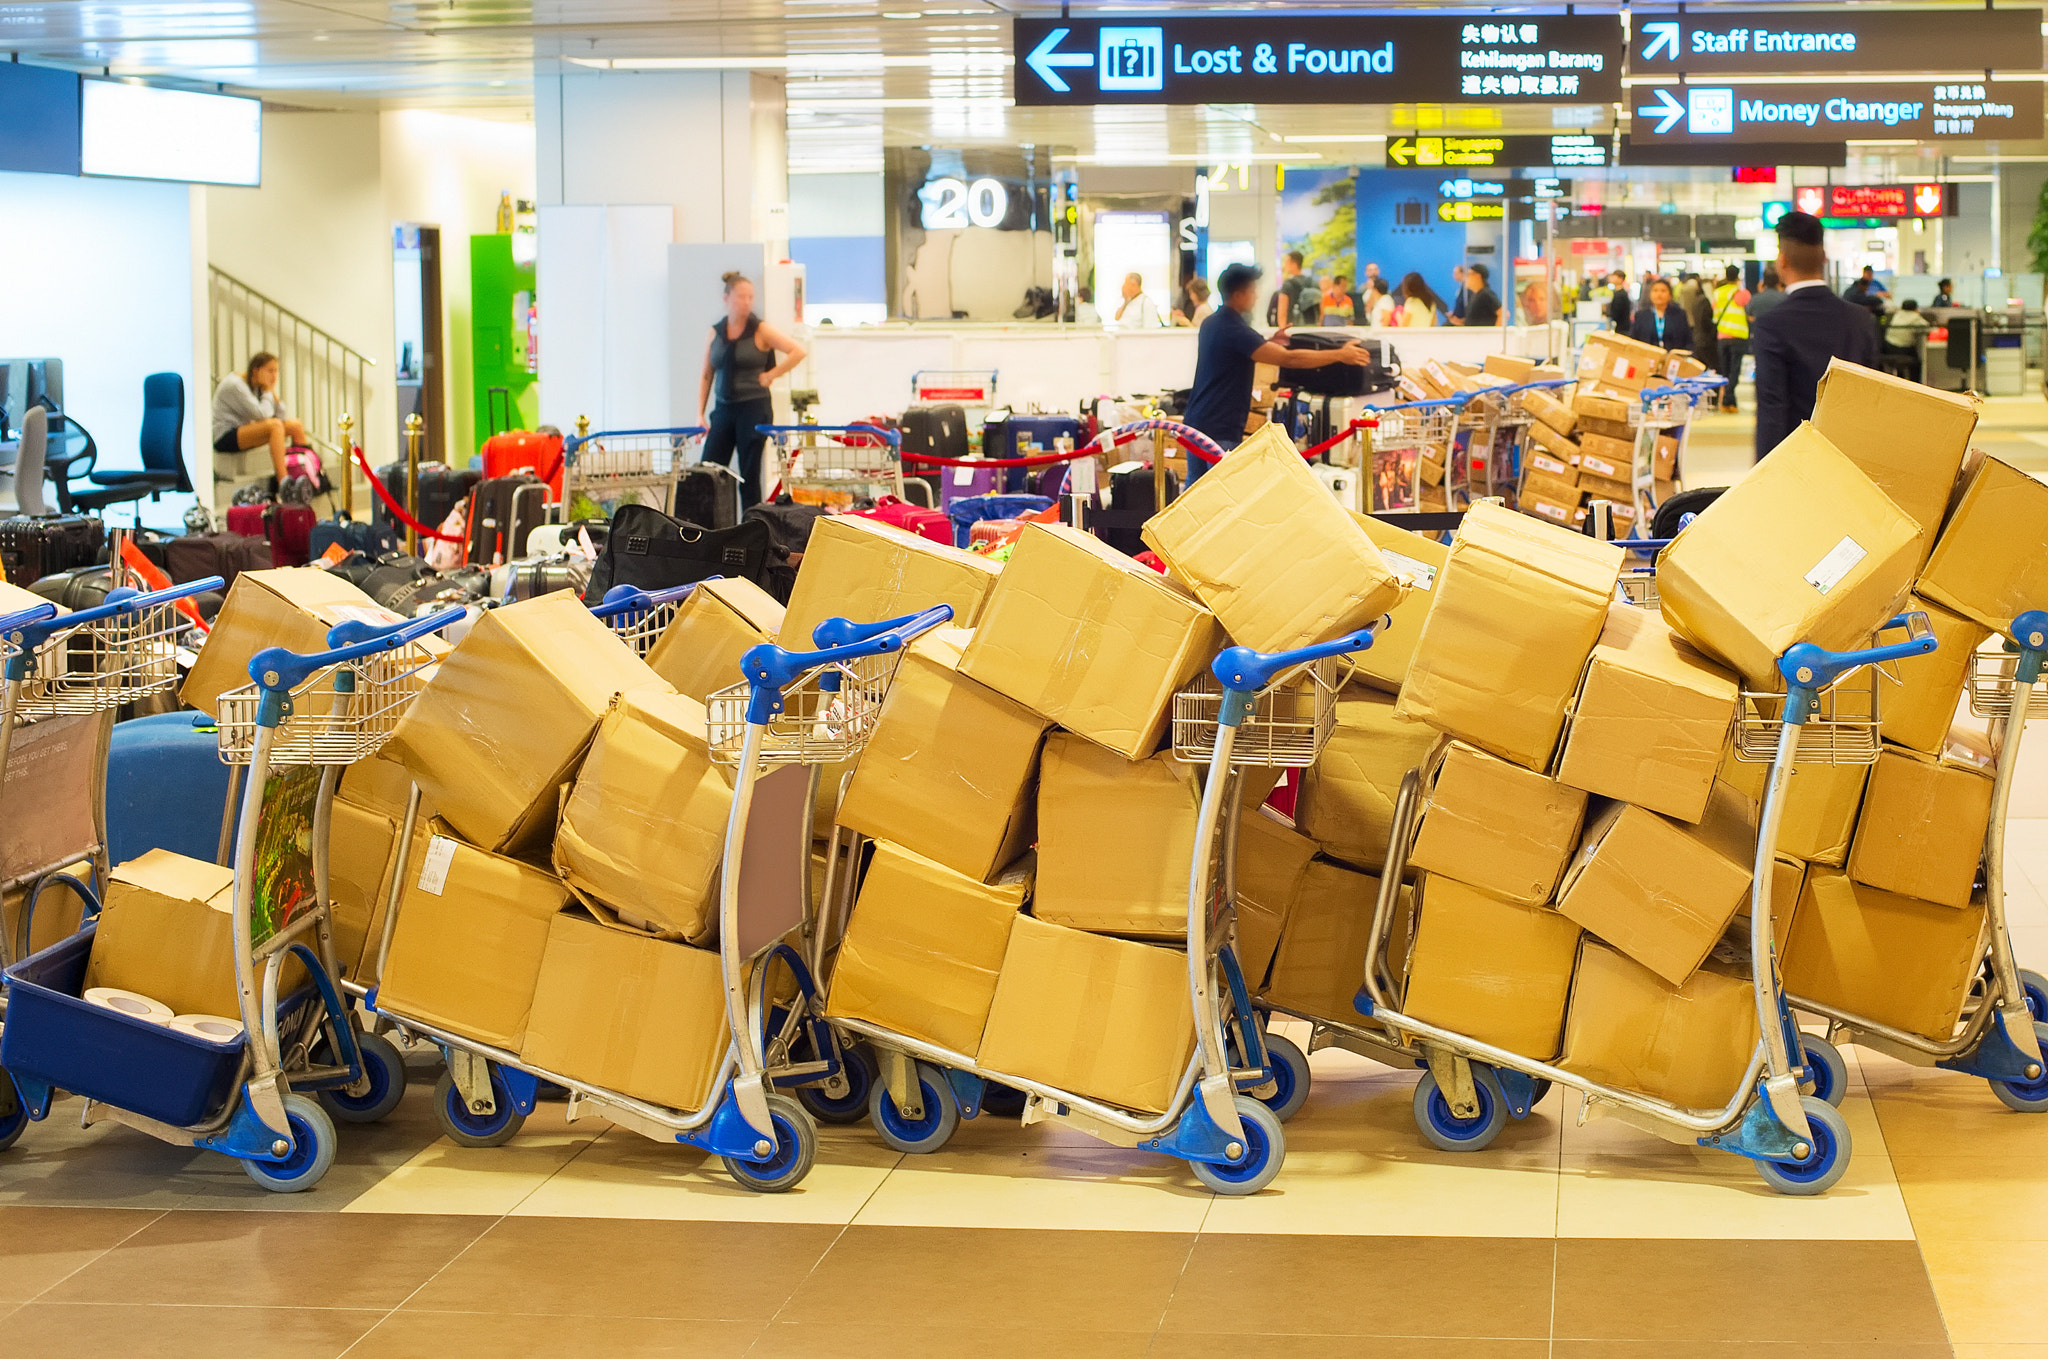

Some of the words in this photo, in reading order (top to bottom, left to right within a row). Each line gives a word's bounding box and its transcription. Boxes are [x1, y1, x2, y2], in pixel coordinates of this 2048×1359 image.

[1691, 28, 1749, 53] Staff
[1753, 29, 1856, 52] Entrance
[1174, 43, 1242, 74] Lost
[1252, 42, 1278, 74] &
[1287, 41, 1394, 74] Found
[1461, 49, 1546, 72] Kehilangan
[1548, 50, 1603, 72] Barang
[1739, 99, 1820, 126] Money
[1824, 97, 1924, 125] Changer
[1982, 103, 2014, 118] Wang
[929, 178, 1007, 228] 20
[1832, 186, 1906, 206] Customs
[28, 751, 38, 761] YOU
[40, 746, 51, 758] GET
[4, 770, 15, 783] GET
